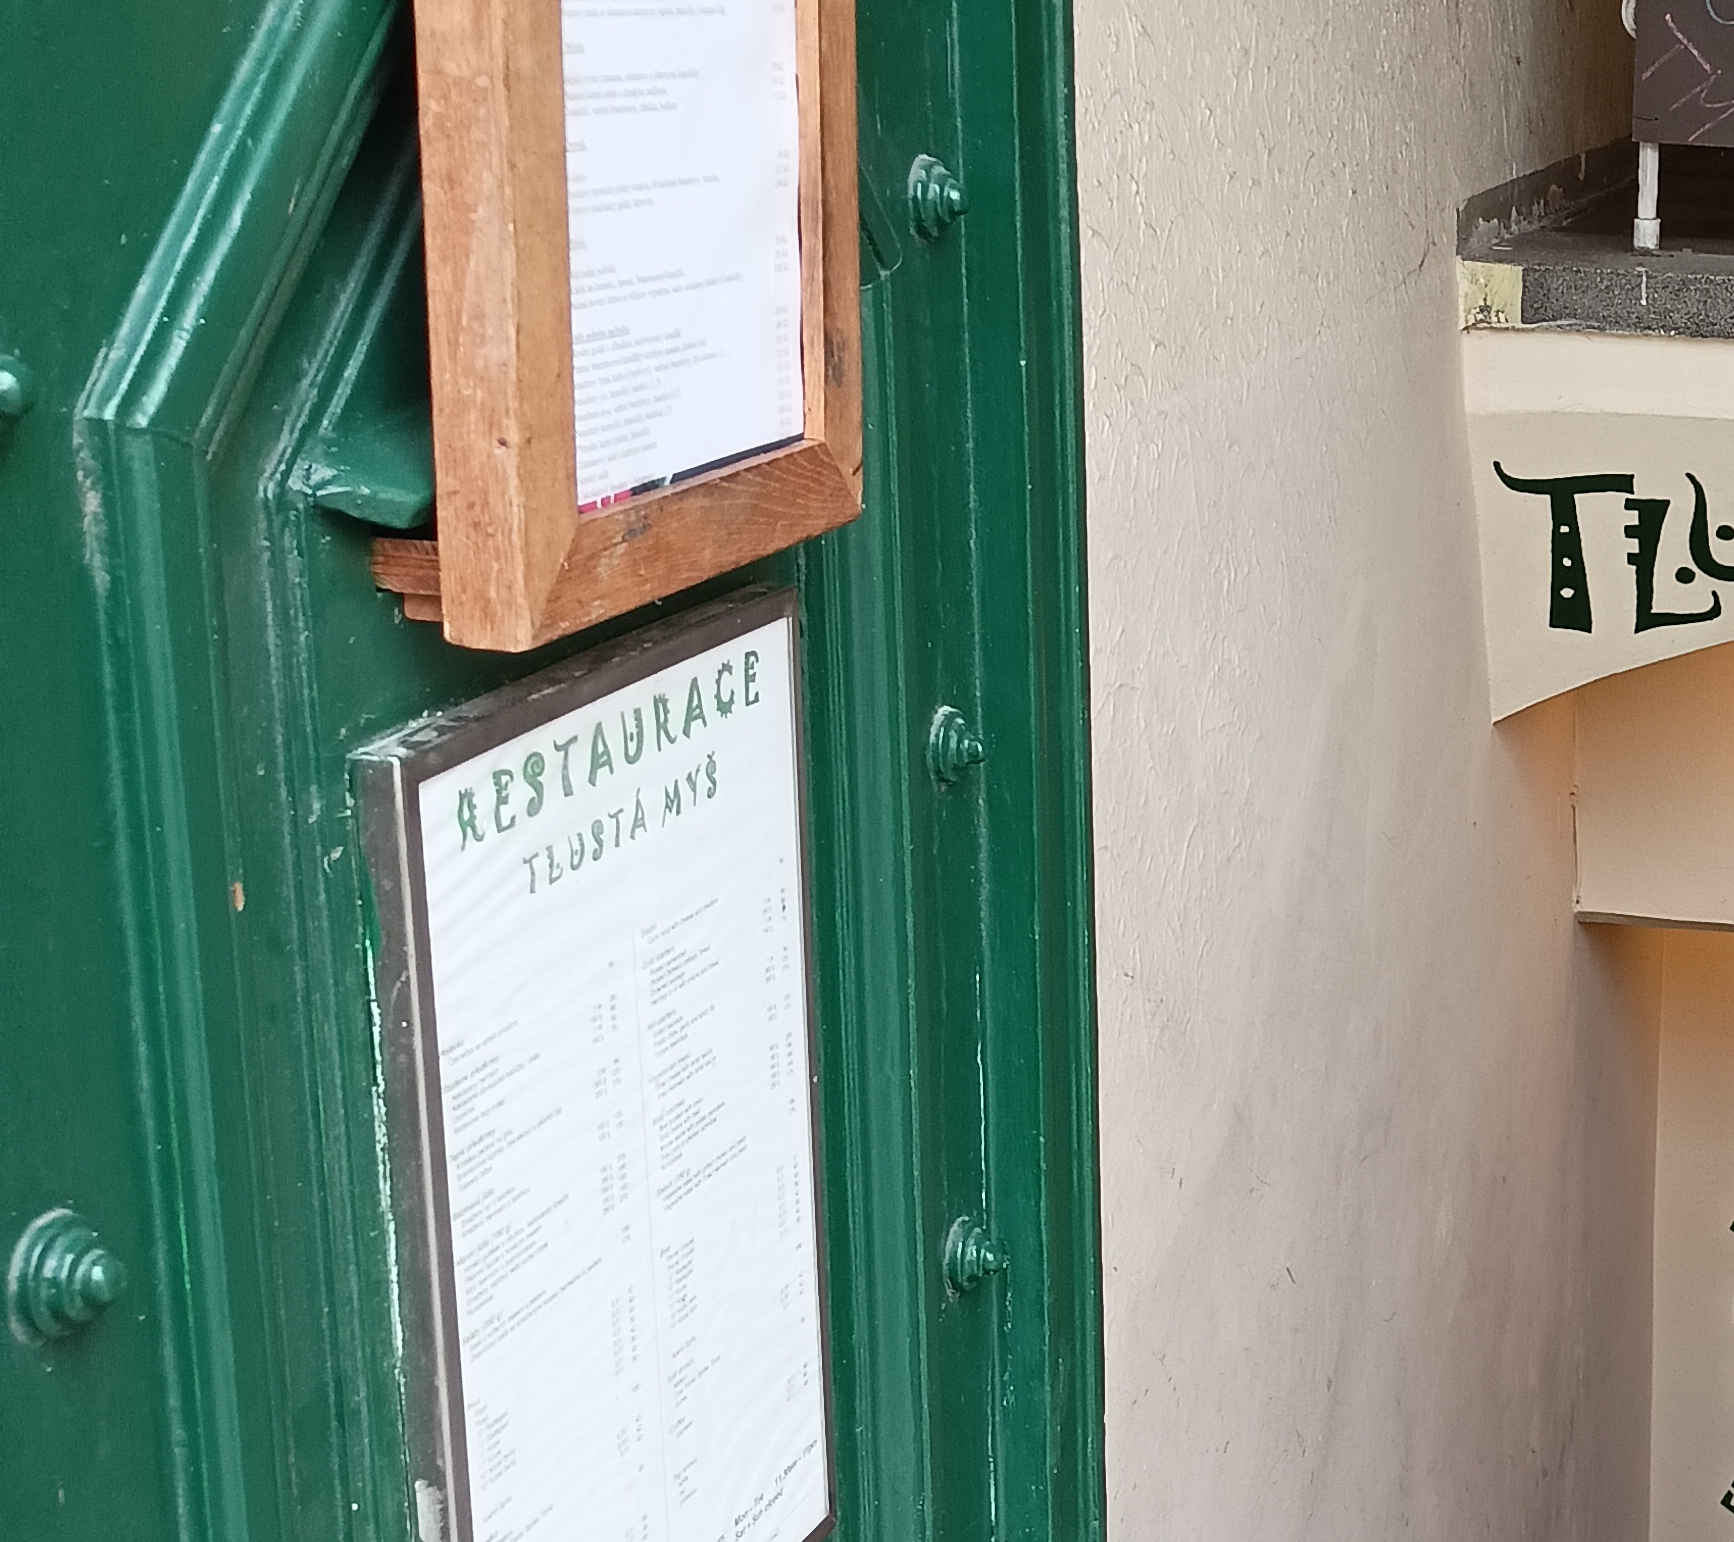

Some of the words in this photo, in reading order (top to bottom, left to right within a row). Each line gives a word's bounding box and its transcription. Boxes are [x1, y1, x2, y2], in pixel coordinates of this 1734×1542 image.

[456, 649, 760, 853] RESTAURACE
[522, 787, 648, 895] TLUSTÁ
[661, 750, 719, 828] MYŠ
